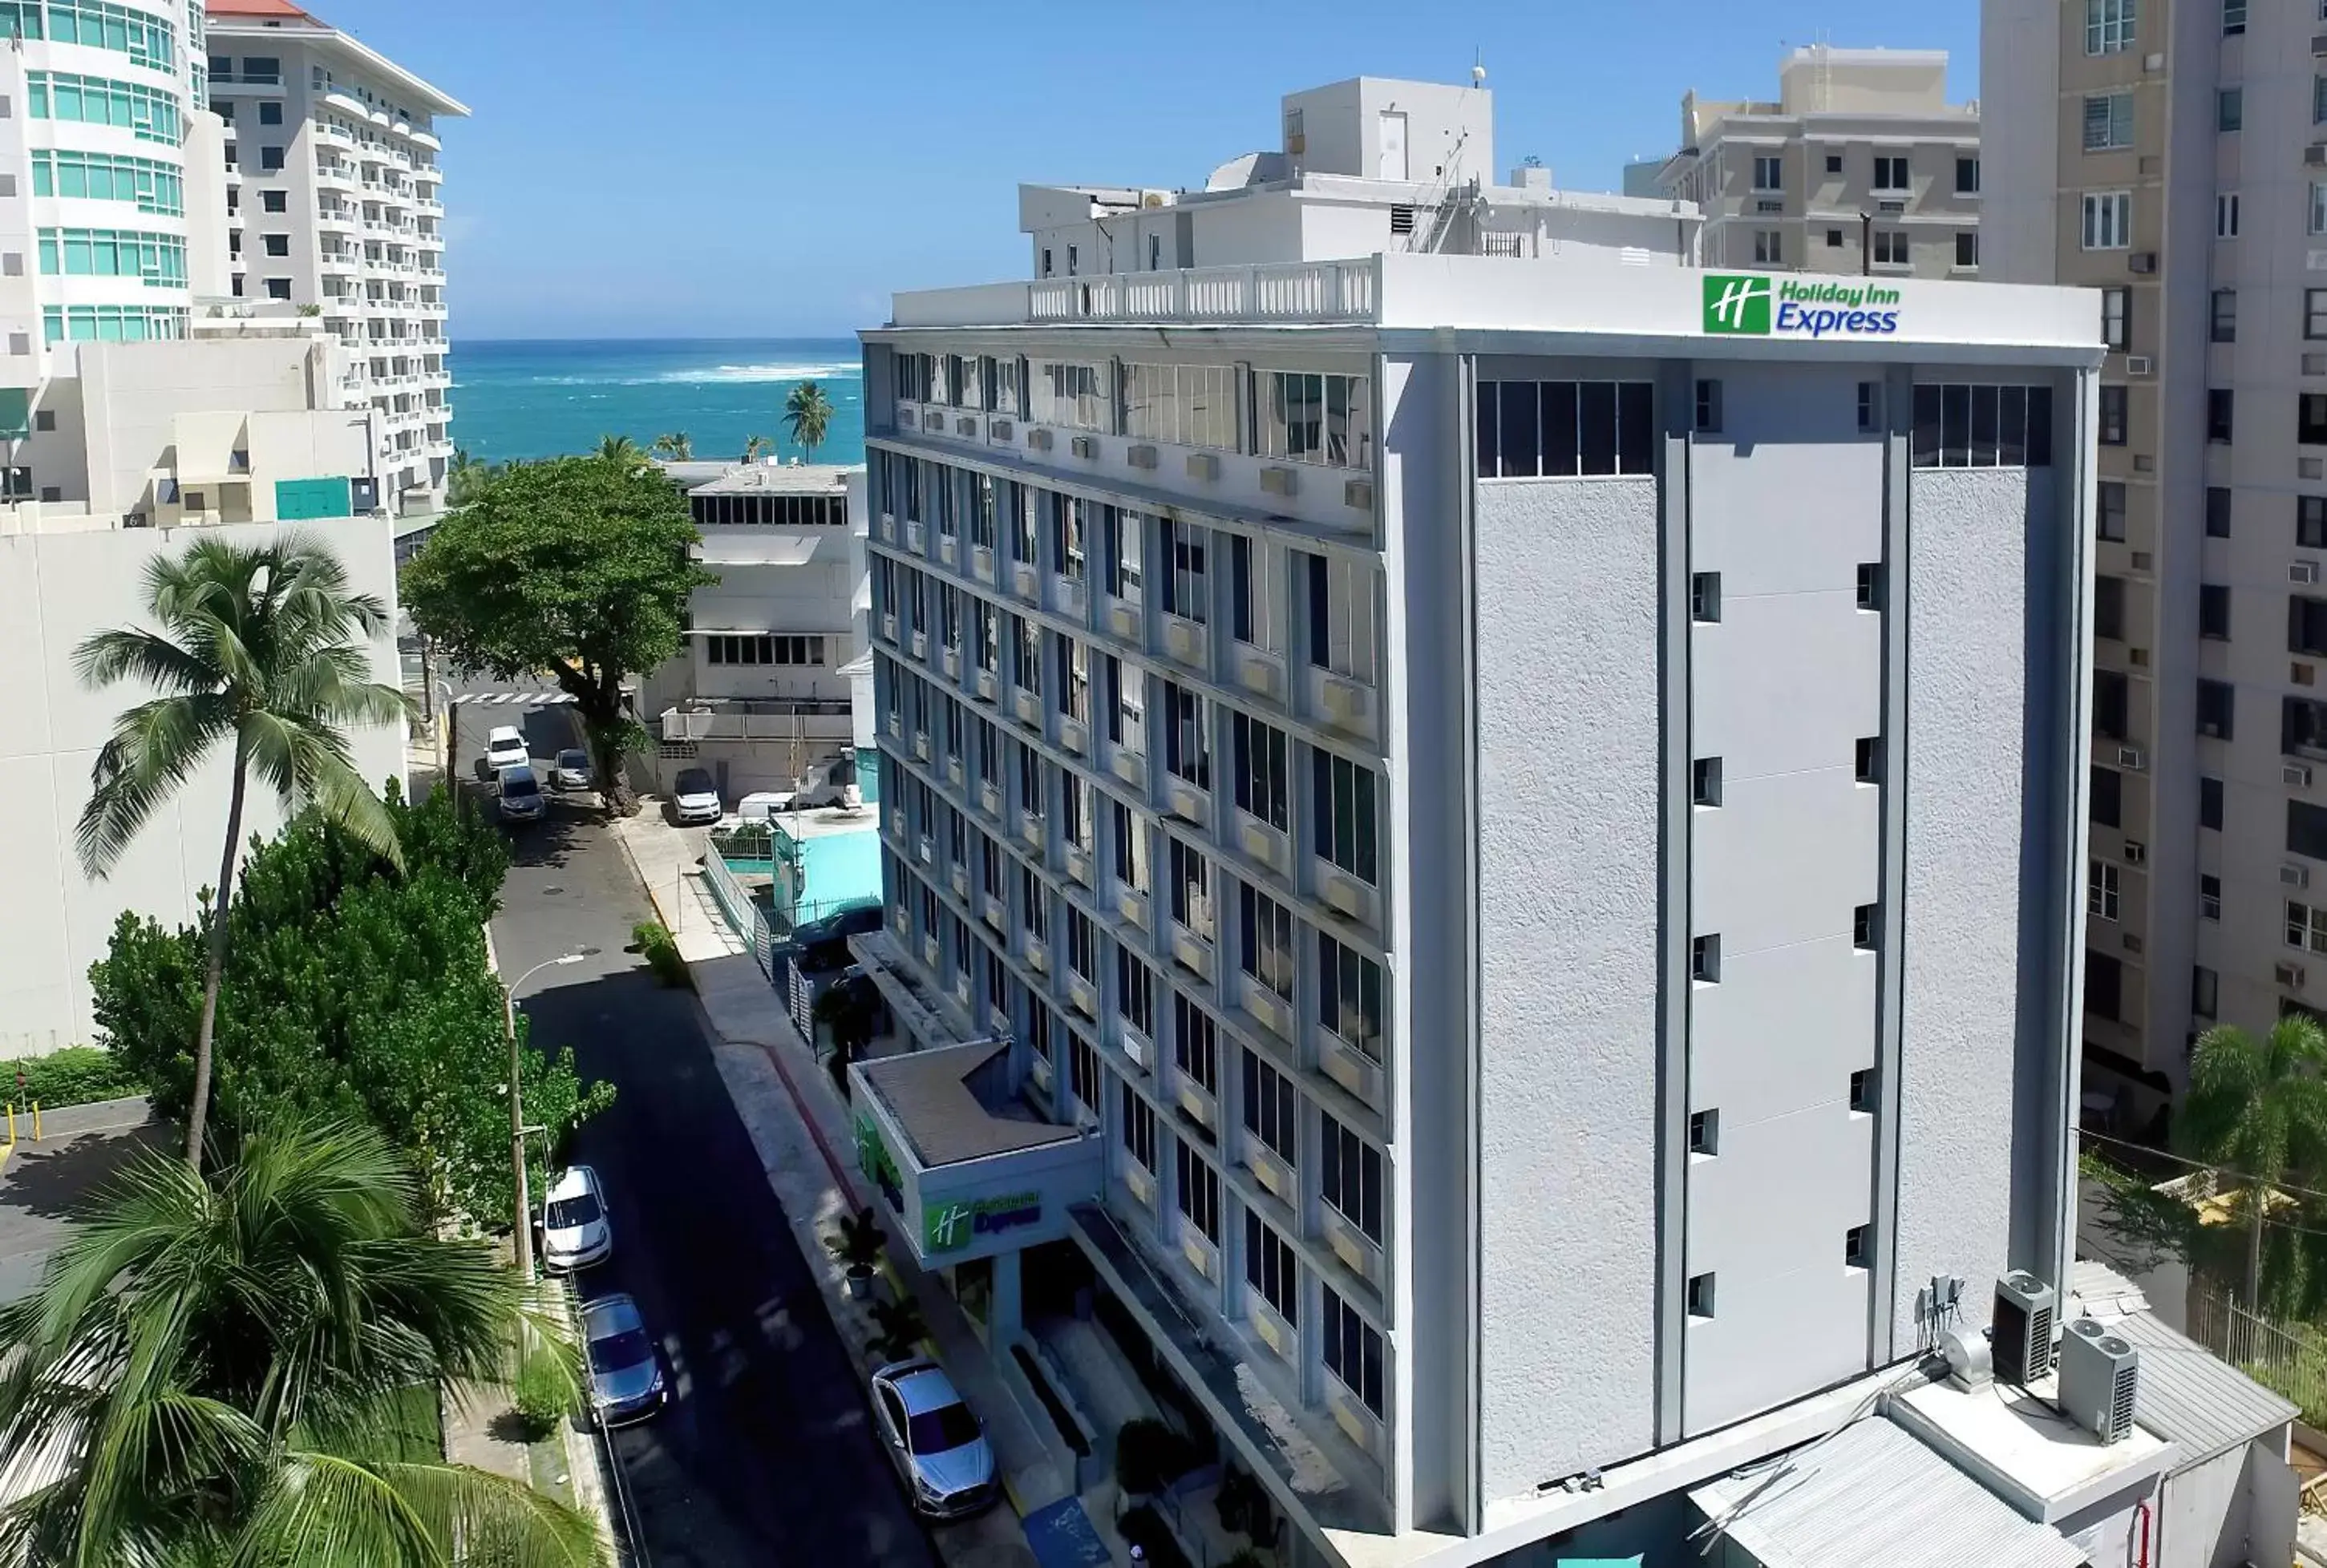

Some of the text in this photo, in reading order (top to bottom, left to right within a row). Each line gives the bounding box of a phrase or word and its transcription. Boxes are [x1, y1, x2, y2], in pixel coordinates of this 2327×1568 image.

[1779, 281, 1900, 307] Holiday Inn
[1776, 302, 1898, 337] Express
